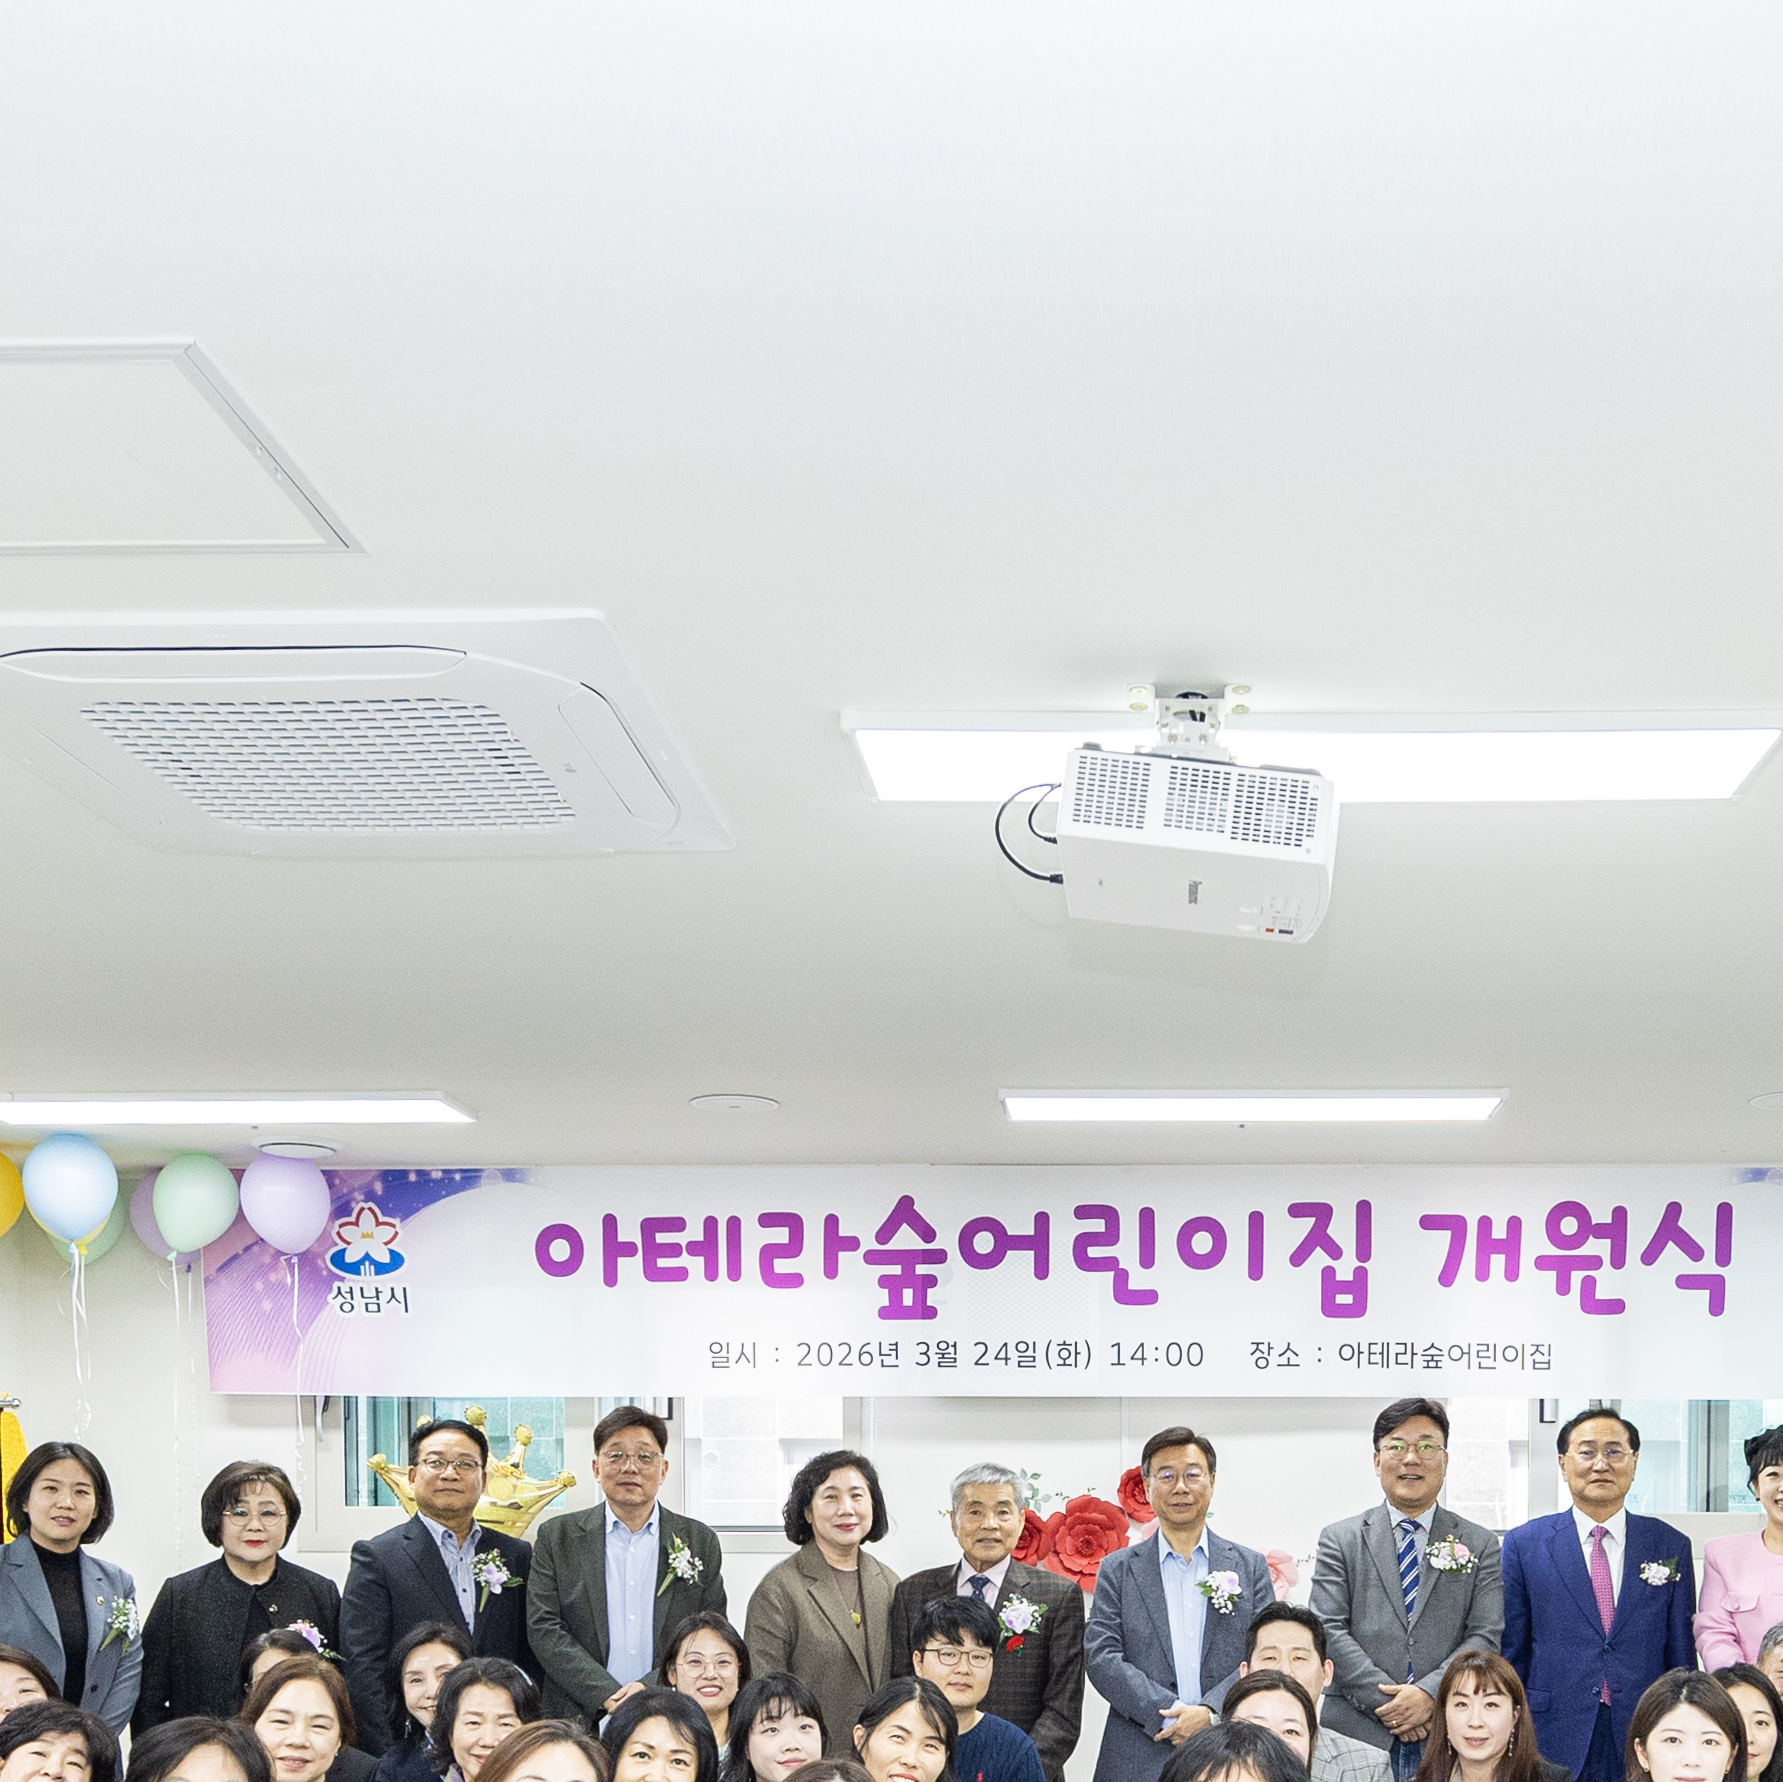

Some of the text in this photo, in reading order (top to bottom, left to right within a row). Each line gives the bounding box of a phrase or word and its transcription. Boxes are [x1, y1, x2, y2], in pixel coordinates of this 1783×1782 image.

[536, 1195, 1733, 1320] 아테라숲어린이집 개원식
[331, 1285, 411, 1314] 성남시
[708, 1341, 759, 1370] 일시
[797, 1341, 902, 1369] 2026년
[915, 1340, 960, 1369] 3월
[973, 1339, 1094, 1371] 24일(화)
[1109, 1341, 1205, 1369] 14:00
[1249, 1340, 1303, 1371] 장소
[1338, 1341, 1553, 1371] 아테라숲어린이집
